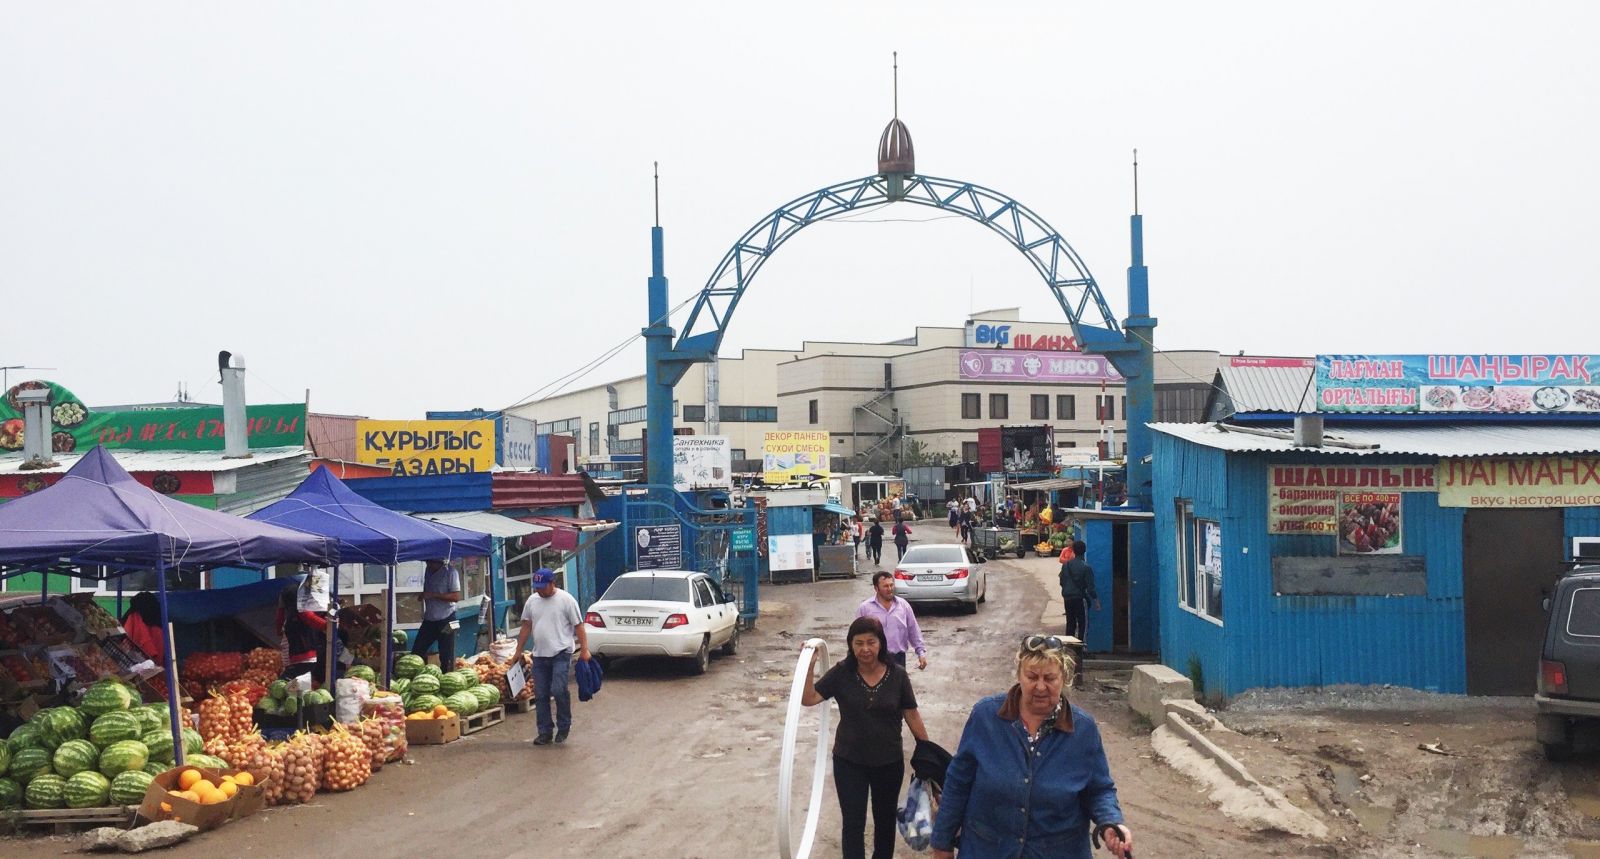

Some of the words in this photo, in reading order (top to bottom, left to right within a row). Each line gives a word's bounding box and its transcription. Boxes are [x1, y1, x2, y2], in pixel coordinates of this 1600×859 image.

[975, 324, 1012, 345] BIG
[1014, 333, 1081, 351] ШАНХ
[991, 356, 1015, 373] ЕТ
[1048, 358, 1099, 375] МЯСО
[1428, 356, 1591, 384] ШАҢЫРАҚ
[1322, 387, 1417, 406] ОРТАЛЫҒЫ
[364, 430, 483, 453] ҚҰРЫЛЫС
[673, 438, 725, 446] Сантехника
[765, 432, 792, 441] ДЕКОР
[794, 432, 828, 441] ПАНЕЛЬ
[796, 444, 825, 453] СМЕСЬ
[1274, 467, 1434, 487] ШАШЛЫК
[1279, 488, 1336, 502] баранина
[1344, 494, 1360, 503] ВСЕ
[1362, 494, 1373, 502] ПО
[1376, 494, 1389, 502] 400
[1471, 495, 1505, 506] вкус
[1279, 504, 1335, 517] окорочка
[1305, 521, 1324, 532] 400
